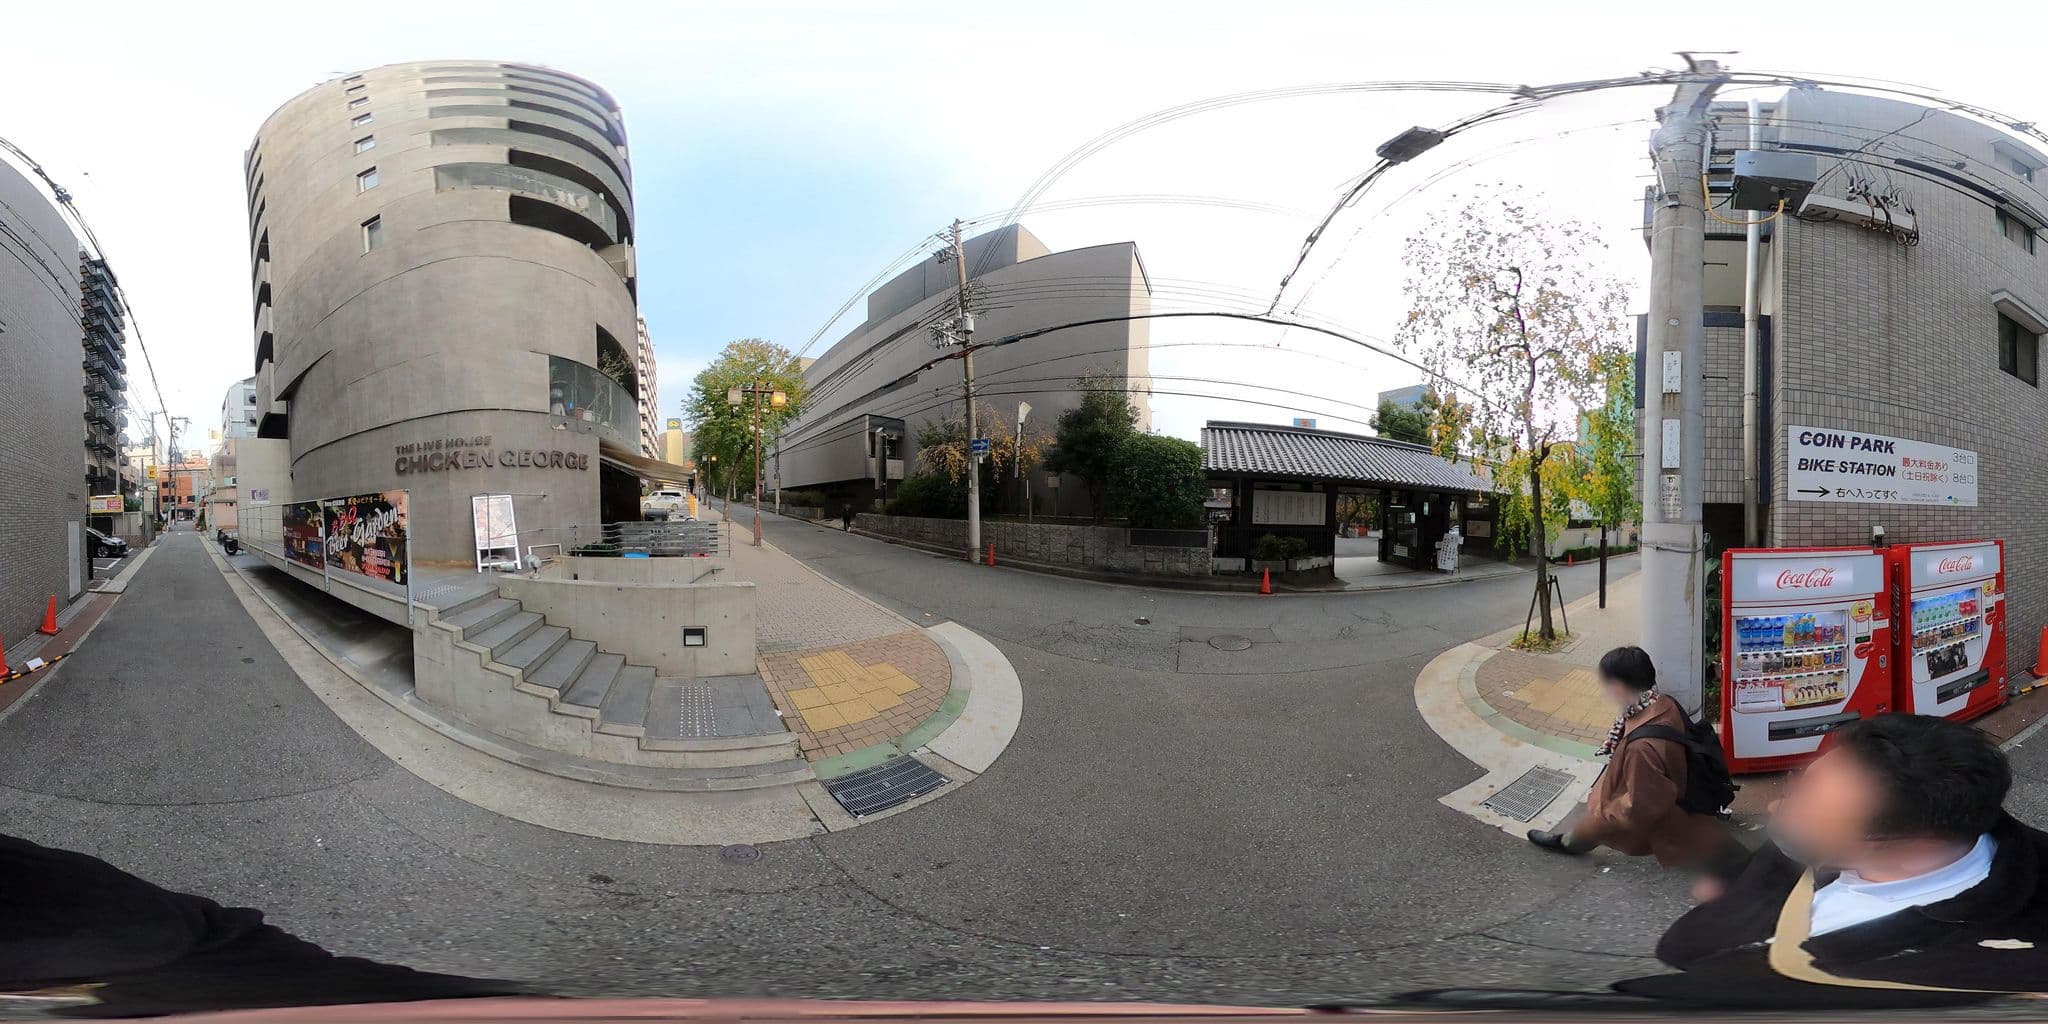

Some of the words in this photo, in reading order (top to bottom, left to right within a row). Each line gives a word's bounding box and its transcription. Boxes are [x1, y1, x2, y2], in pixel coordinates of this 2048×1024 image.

[395, 445, 414, 456] THE
[416, 440, 442, 452] LIVE
[445, 436, 493, 449] HOUSE
[1799, 431, 1845, 449] COIN
[1850, 436, 1895, 454] PARK
[395, 451, 494, 475] CHICKEN
[499, 450, 590, 471] GEORGE
[1797, 458, 1835, 473] BIKE
[1838, 462, 1896, 477] STATION
[1902, 457, 1949, 472] 最大料金あり
[1835, 488, 1898, 500] 右へ入ってすぐ
[326, 533, 348, 556] Beer
[352, 507, 398, 548] Garden
